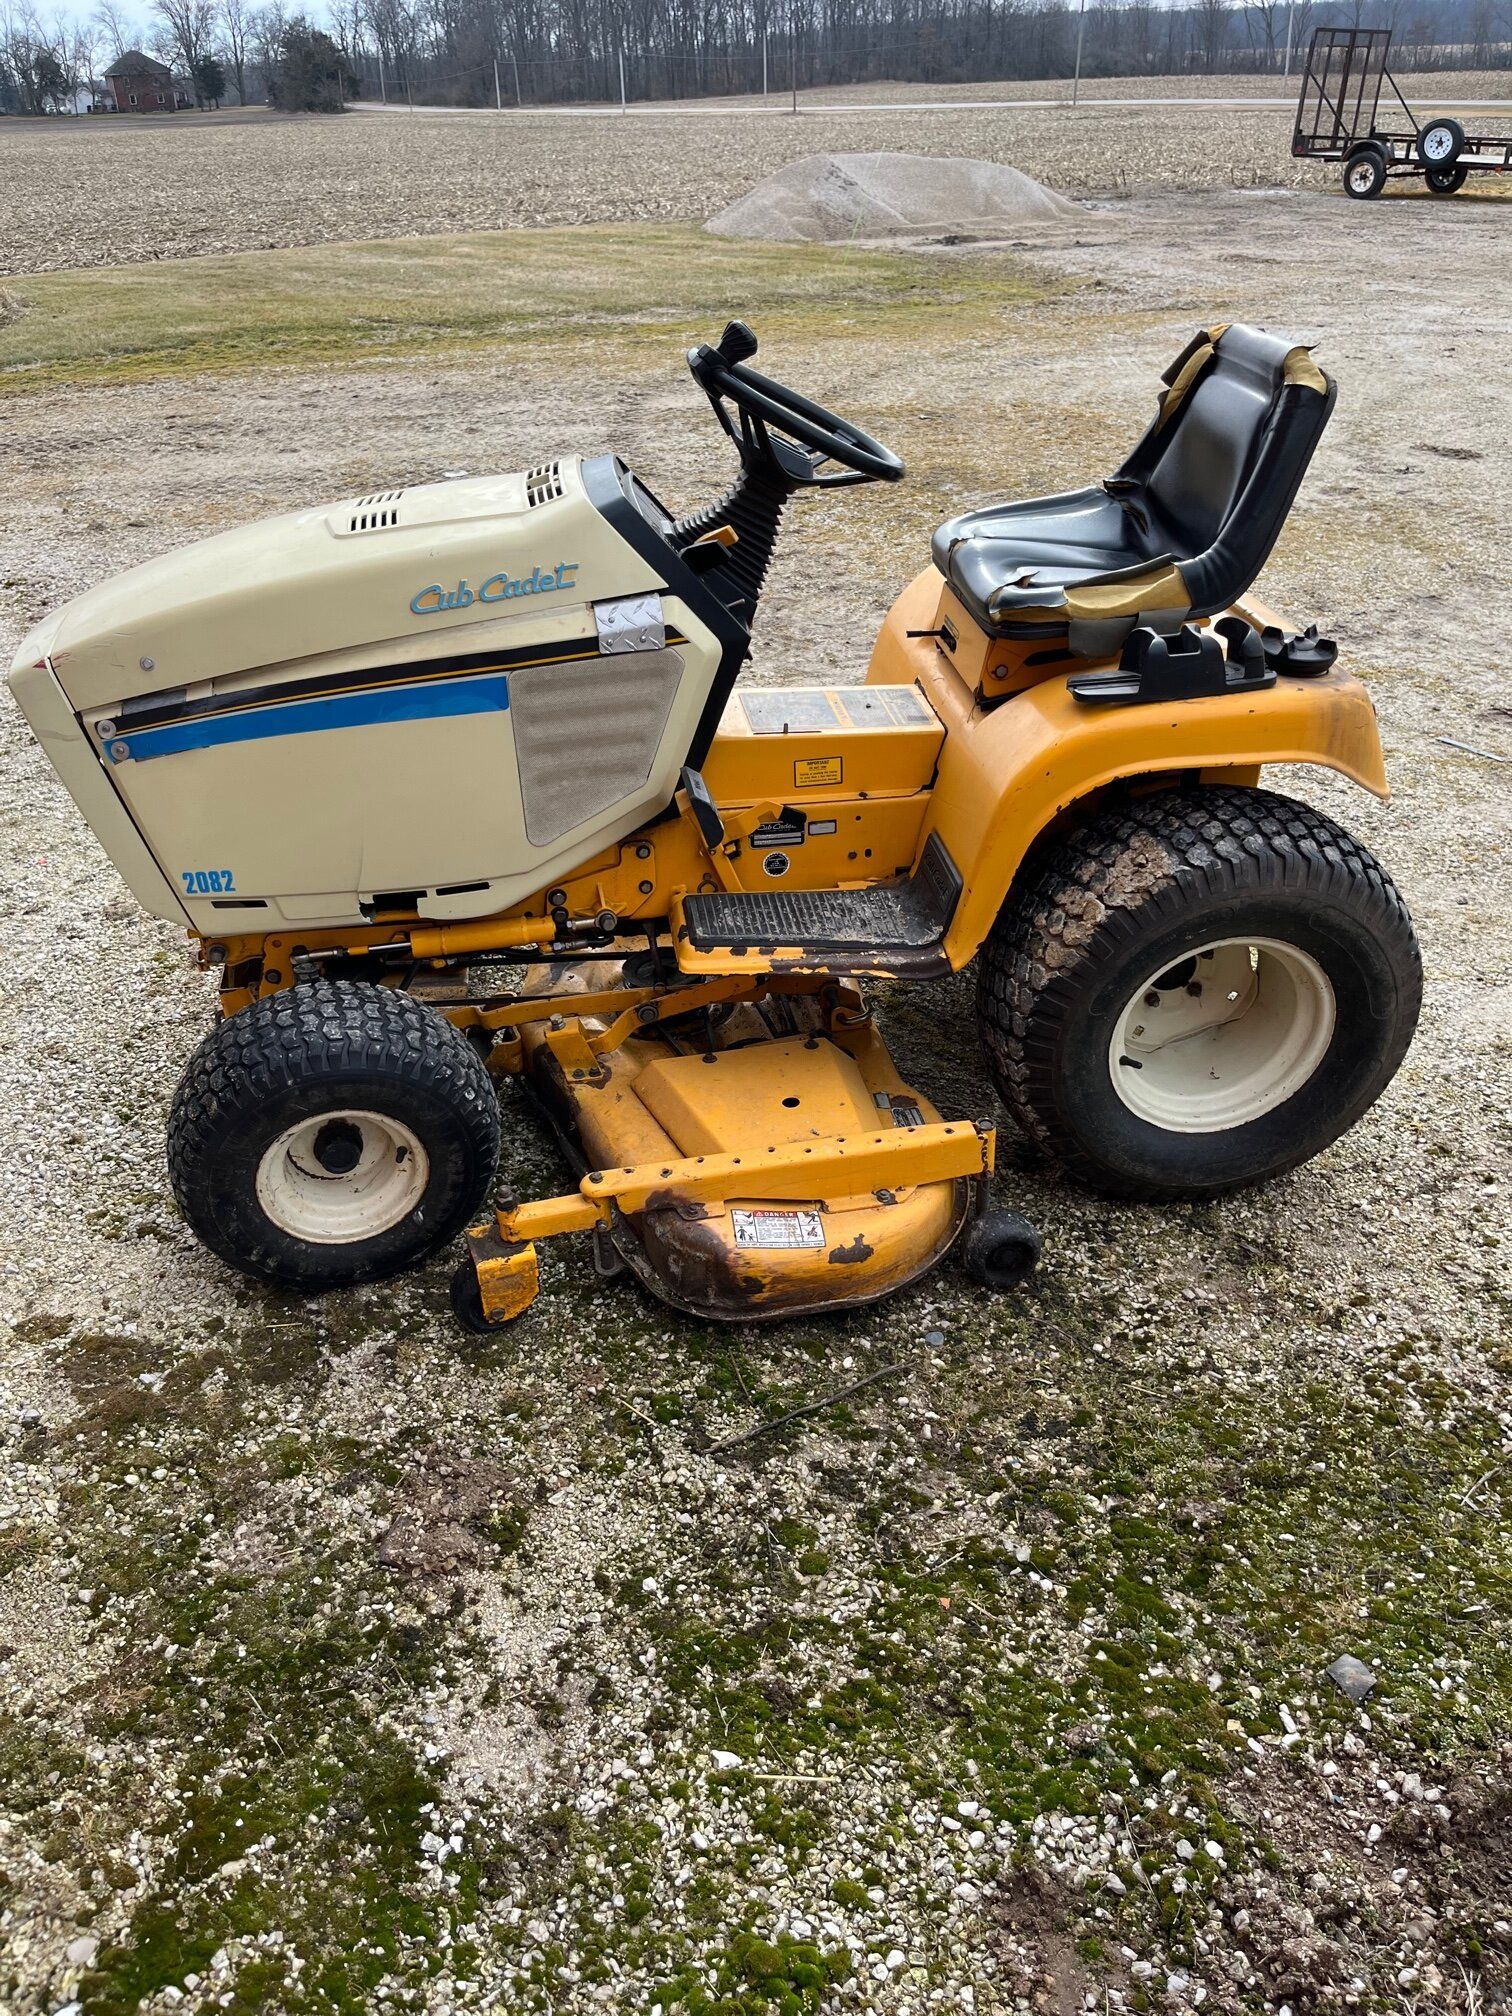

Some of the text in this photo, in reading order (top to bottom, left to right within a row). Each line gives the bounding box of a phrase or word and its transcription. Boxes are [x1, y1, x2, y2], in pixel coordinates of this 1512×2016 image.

[410, 560, 579, 615] Cub Cadet
[182, 869, 236, 894] 2082
